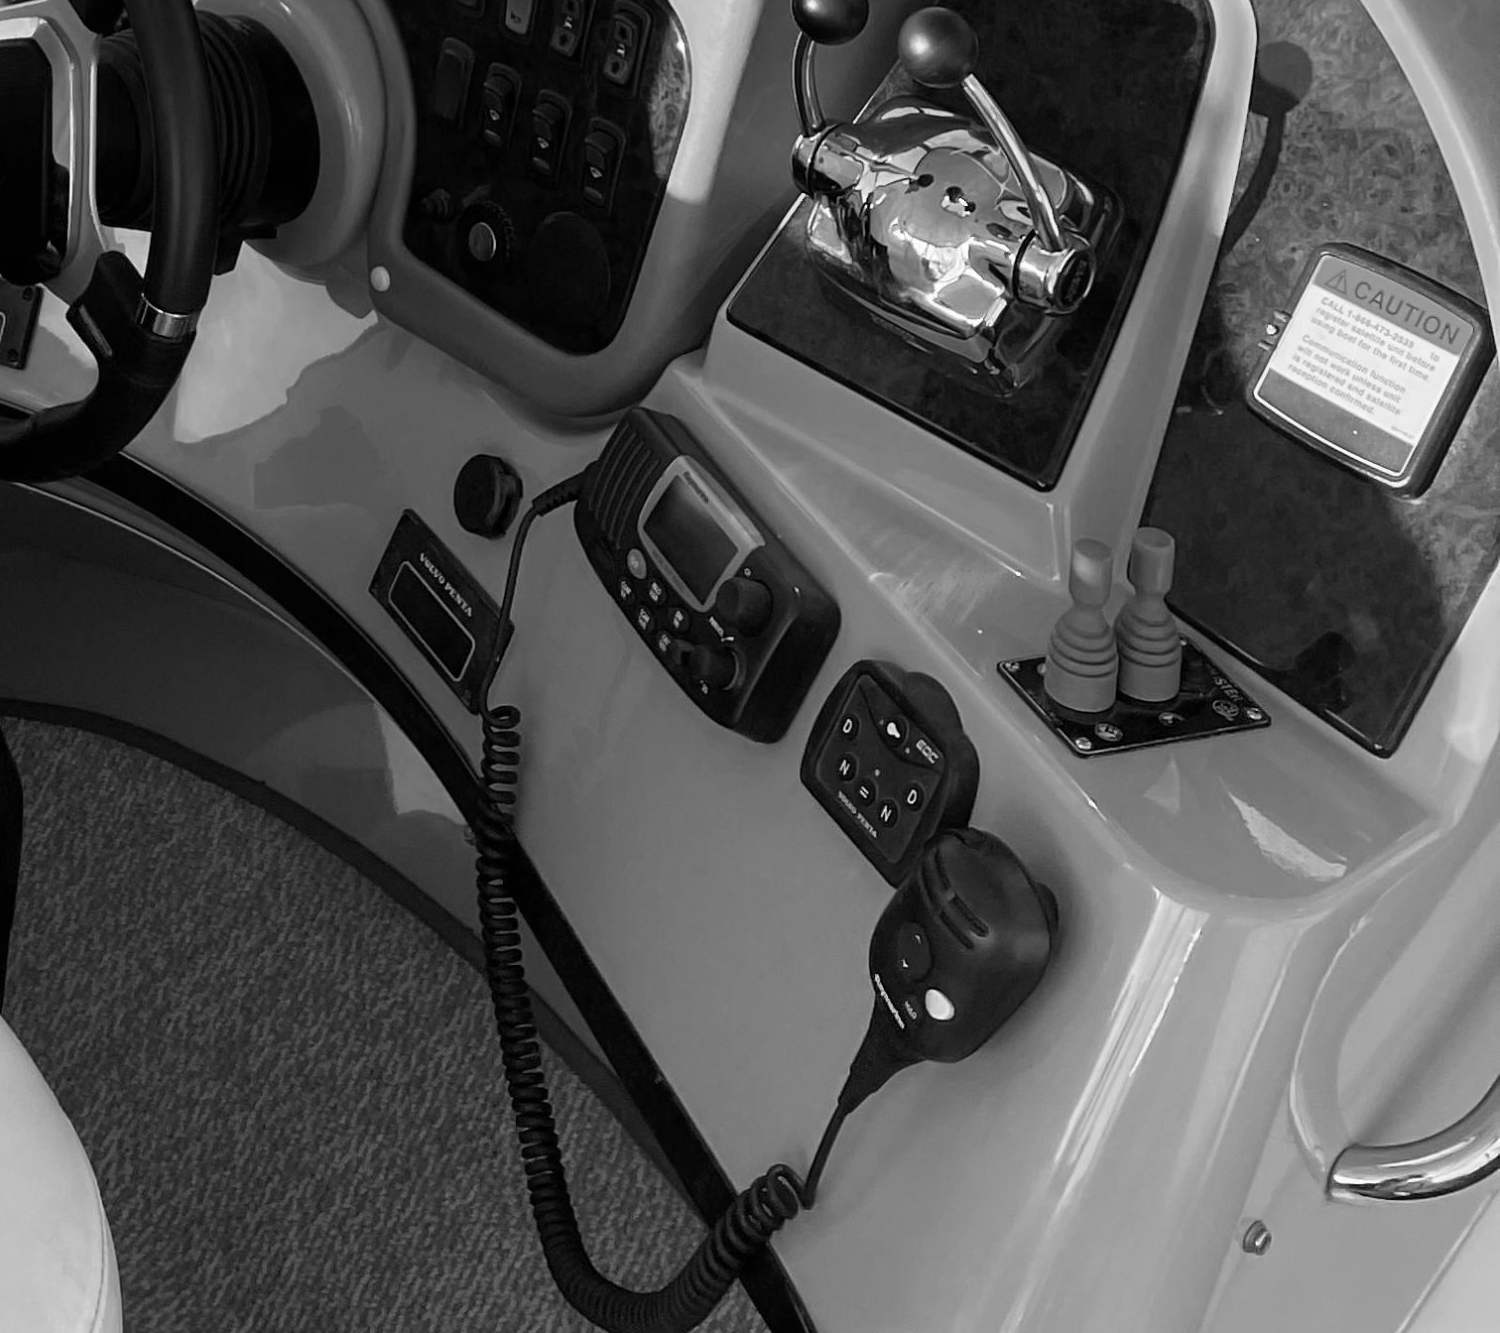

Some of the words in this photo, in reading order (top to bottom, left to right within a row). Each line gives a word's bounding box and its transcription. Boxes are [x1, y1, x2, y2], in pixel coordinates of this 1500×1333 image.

[1322, 298, 1344, 313] CALL
[1430, 353, 1439, 362] to
[1354, 281, 1461, 345] CAUTION
[1303, 336, 1368, 374] Communication
[1371, 372, 1405, 393] function
[1311, 317, 1335, 333] using
[1337, 330, 1356, 343] boat
[1359, 341, 1371, 350] for
[1374, 349, 1386, 359] the
[1390, 357, 1407, 369] first
[1316, 307, 1348, 328] register
[1352, 325, 1385, 346] satellite
[1388, 344, 1404, 355] unit
[1406, 353, 1435, 372] before
[1288, 365, 1327, 390] reception
[1302, 360, 1345, 387] registered
[1348, 383, 1364, 395] and
[1367, 393, 1401, 414] satellite
[1314, 354, 1328, 364] not
[1331, 362, 1350, 376] work
[1353, 374, 1381, 392] unless
[1384, 390, 1401, 402] unit
[420, 552, 445, 584] VOLVO
[444, 581, 472, 617] PENTA
[842, 718, 853, 733] D
[839, 759, 850, 776] N
[916, 739, 939, 764] EDC
[880, 805, 891, 822] N
[906, 789, 918, 804] D
